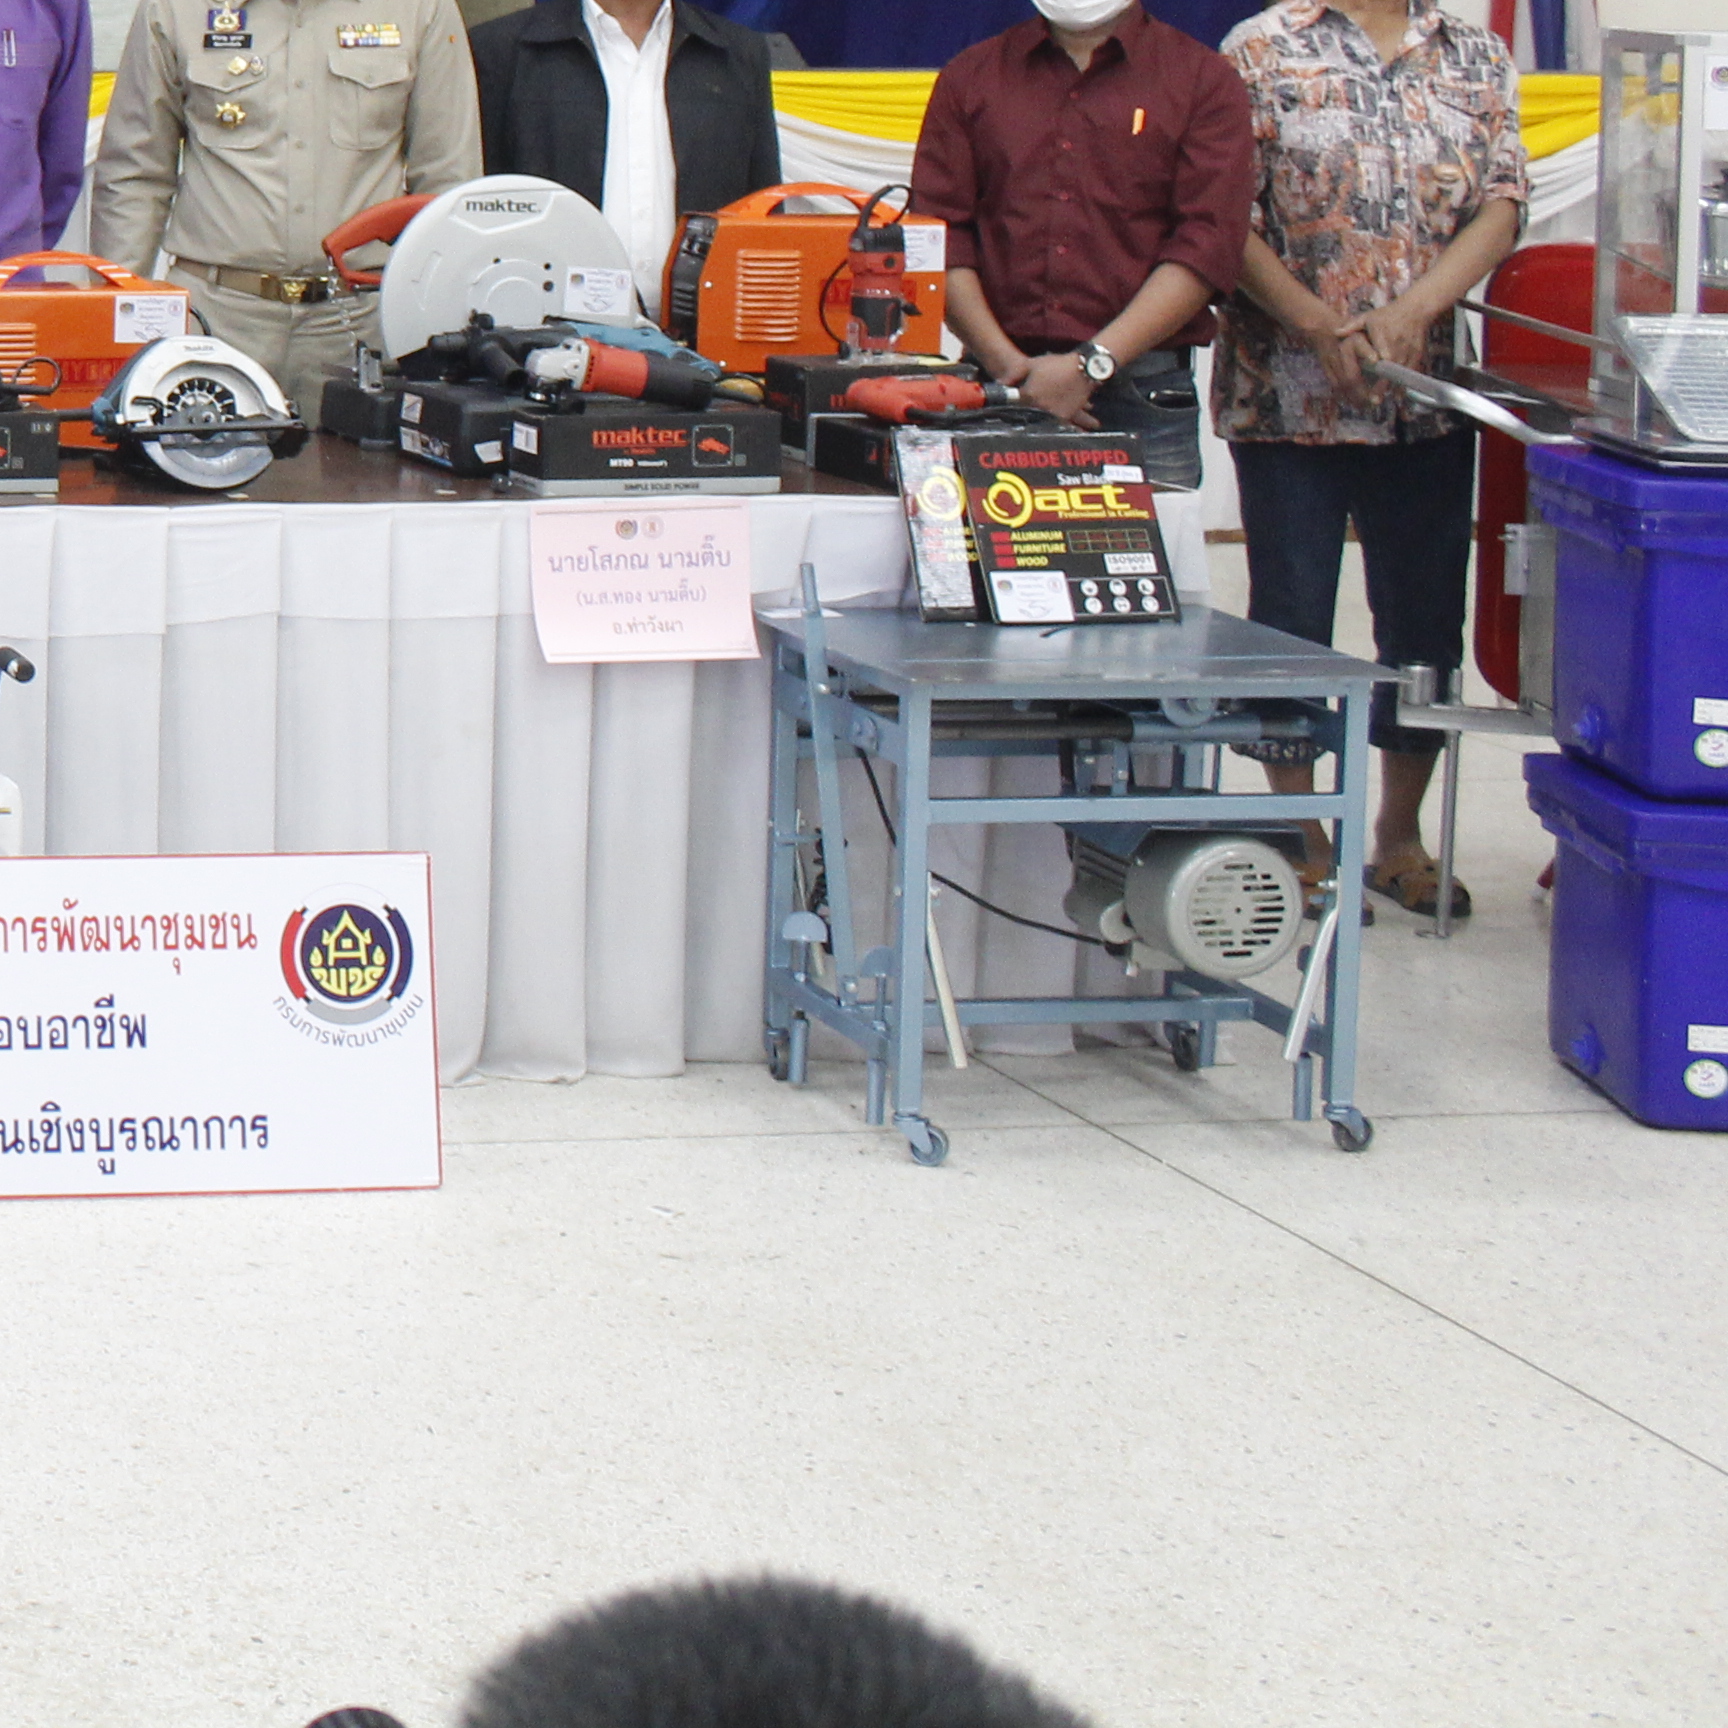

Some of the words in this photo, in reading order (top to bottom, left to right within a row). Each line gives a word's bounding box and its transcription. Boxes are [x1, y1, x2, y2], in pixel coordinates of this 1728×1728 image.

[464, 197, 539, 216] maktec
[591, 425, 688, 448] maktec
[978, 449, 1062, 470] CARBIDE
[1063, 448, 1130, 467] TIPPED
[1056, 472, 1082, 486] Saw
[1009, 530, 1064, 542] ALUMINUM
[1012, 542, 1067, 554] FURNITURE
[547, 545, 650, 573] นายโสภณ
[1015, 555, 1049, 567] WOOD
[271, 993, 425, 1049] กรมการพัฒนาชุมชน
